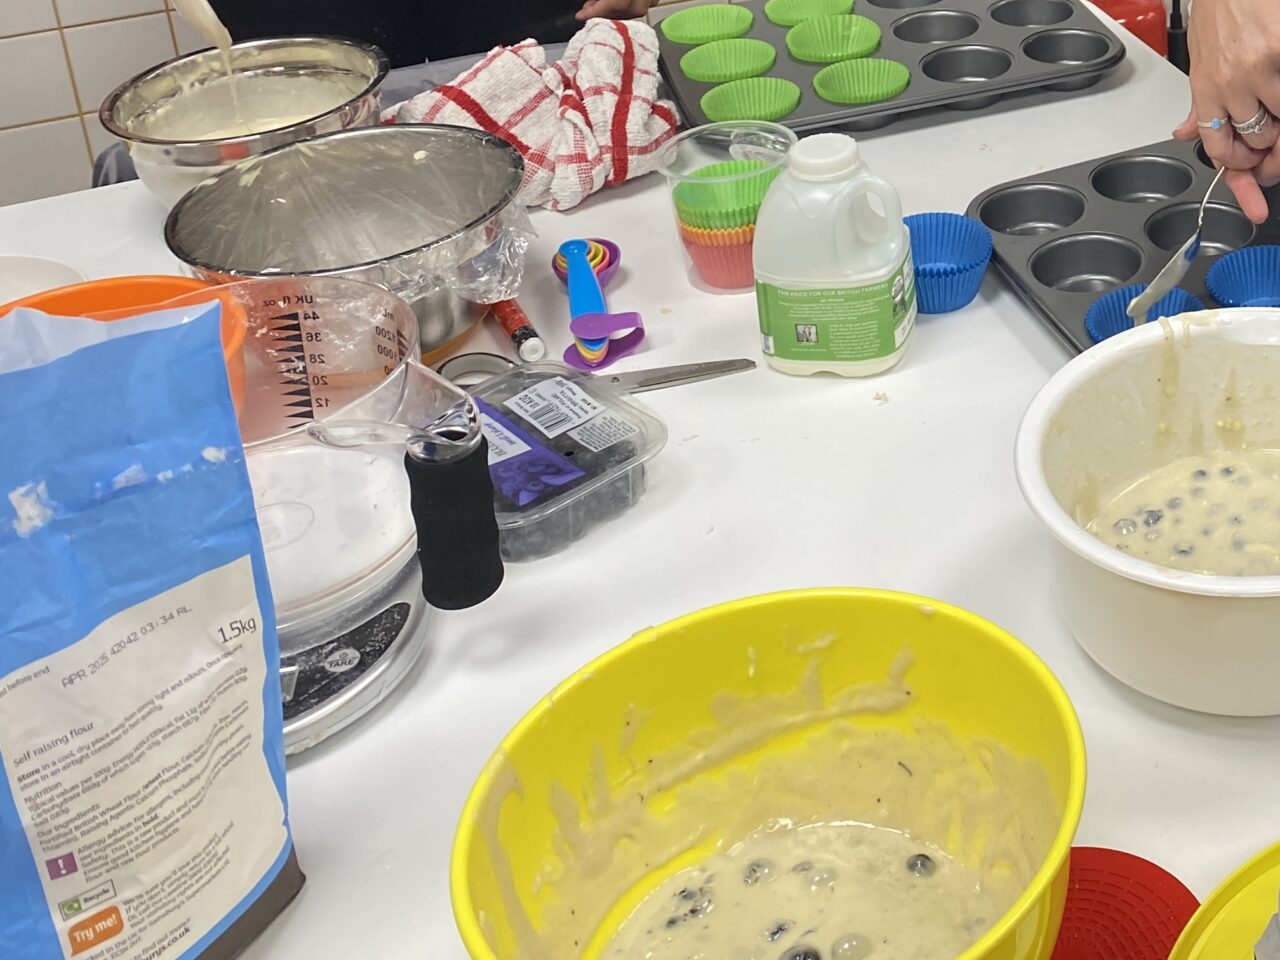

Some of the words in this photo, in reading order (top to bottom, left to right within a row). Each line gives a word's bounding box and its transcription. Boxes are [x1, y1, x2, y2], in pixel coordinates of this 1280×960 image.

[837, 288, 861, 296] BRITISH
[217, 615, 257, 645] 1.5kg
[7, 673, 34, 690] before
[33, 665, 51, 678] end
[61, 668, 88, 689] APR
[88, 653, 110, 675] 2025
[328, 659, 353, 669] TARE
[14, 751, 30, 766] Self
[33, 735, 69, 756] raising
[70, 723, 93, 738] flour
[17, 766, 42, 783] Store
[41, 763, 50, 771] in
[57, 751, 76, 763] cool,
[77, 744, 90, 753] dry
[91, 733, 110, 747] place
[154, 688, 170, 700] light
[170, 680, 183, 691] and
[20, 775, 40, 792] store
[50, 768, 60, 776] an
[62, 753, 90, 771] airtight
[89, 734, 122, 755] container
[24, 781, 62, 803] Nutrition
[56, 784, 79, 798] values
[80, 776, 92, 786] per
[30, 792, 80, 820] Carbohydrate
[37, 829, 52, 838] Our
[54, 804, 100, 831] Ingredients
[39, 829, 73, 846] Fortified
[74, 815, 98, 831] British
[99, 801, 123, 817] Wheat
[80, 819, 108, 836] Raising
[78, 838, 106, 854] Allergy
[91, 831, 134, 855] ingredients
[111, 844, 126, 854] This
[83, 888, 109, 903] Recycle
[73, 925, 95, 945] Try
[94, 914, 118, 932] me!
